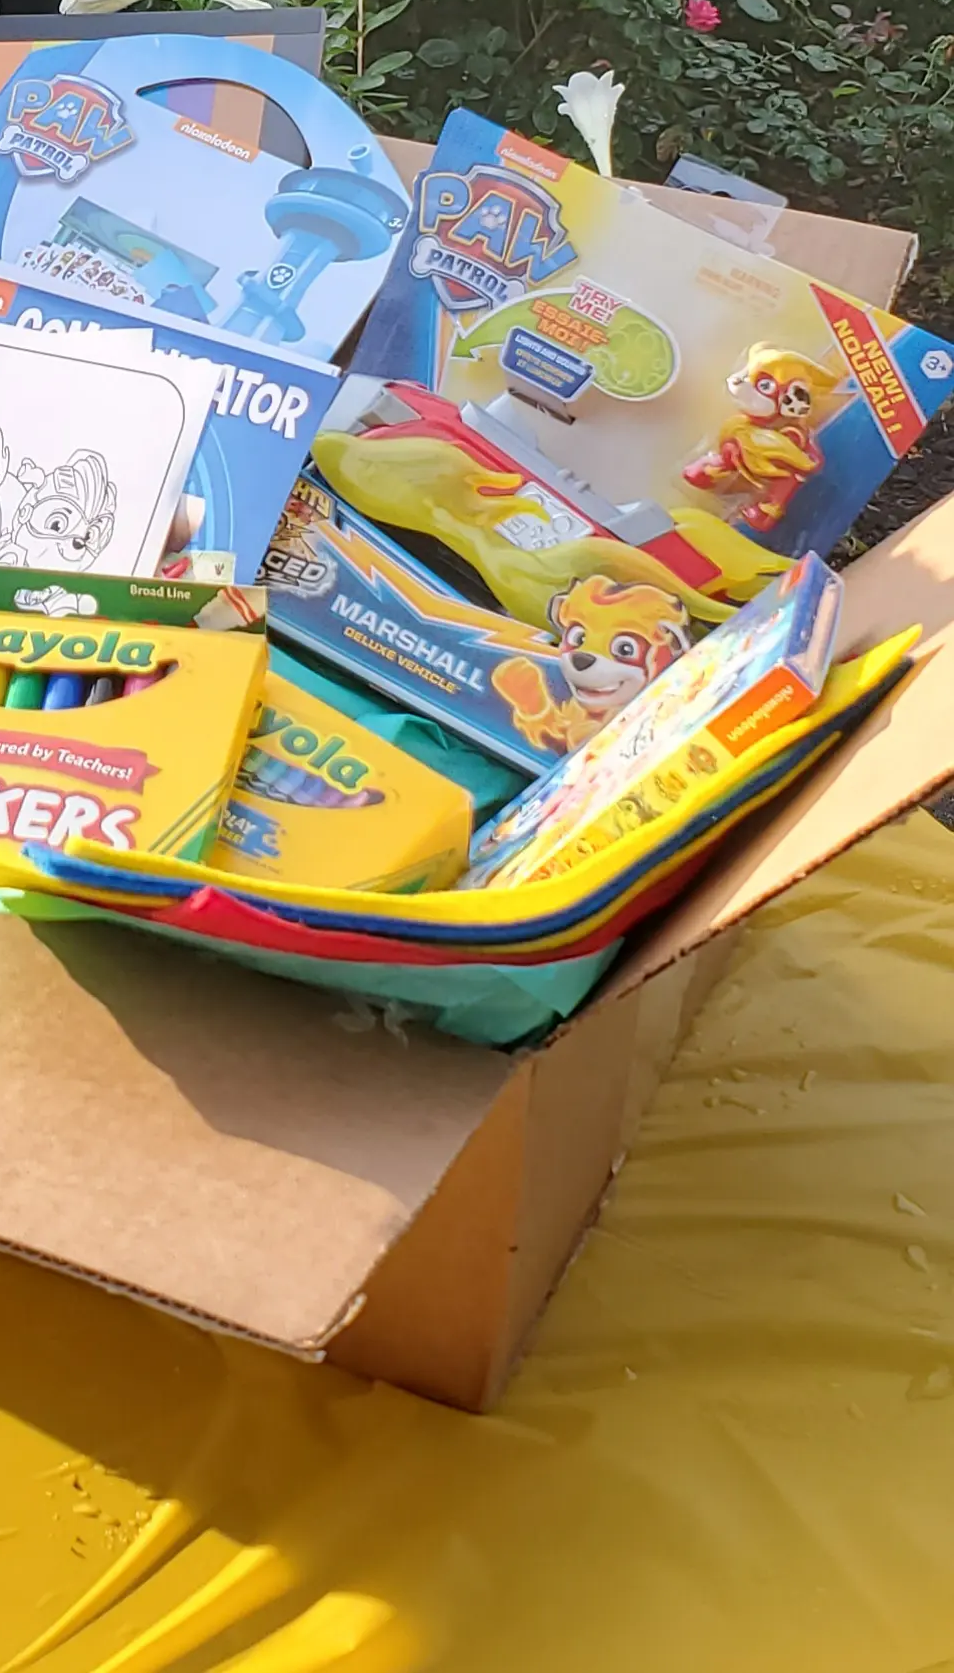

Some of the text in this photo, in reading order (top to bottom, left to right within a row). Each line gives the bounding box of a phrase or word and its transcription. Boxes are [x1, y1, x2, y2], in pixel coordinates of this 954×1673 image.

[7, 79, 135, 160] PAW
[180, 123, 251, 160] nickelodeon
[9, 131, 74, 172] PATROL
[418, 172, 579, 286] PAW
[426, 248, 509, 302] PATROL
[579, 282, 624, 311] TRY
[571, 296, 613, 324] ME!
[863, 340, 905, 405] NEW!
[925, 356, 947, 373] 3+
[130, 584, 191, 600] Broad Line
[330, 594, 485, 694] MARSHALL
[343, 626, 459, 695] DELUXE VEHICLE
[33, 744, 54, 762] by
[57, 749, 134, 781] Teachers!
[247, 708, 369, 789] yola
